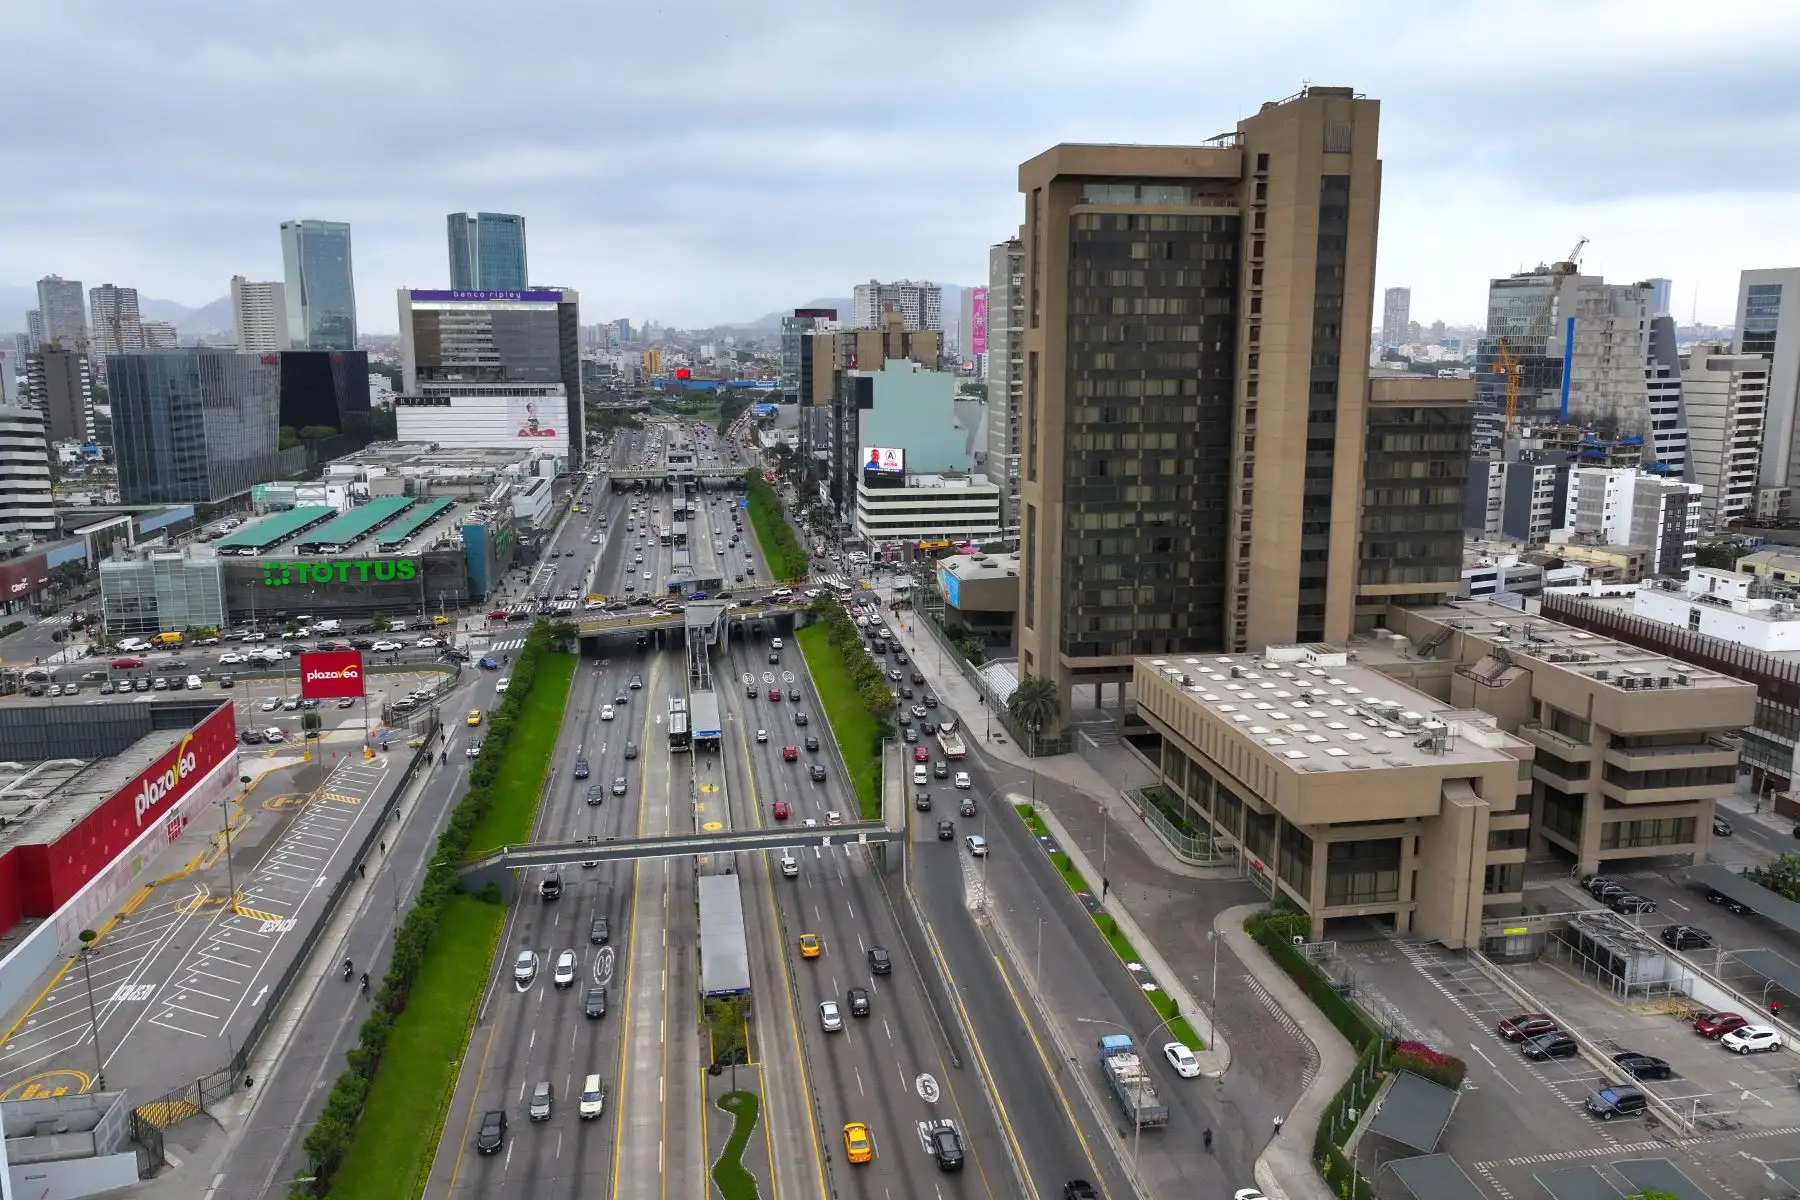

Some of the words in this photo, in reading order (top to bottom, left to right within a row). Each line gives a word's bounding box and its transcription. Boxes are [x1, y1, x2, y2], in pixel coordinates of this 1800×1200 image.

[489, 291, 521, 299] ripley
[292, 559, 416, 584] TOTTUS
[306, 664, 358, 683] plazavea
[134, 733, 196, 828] plazavea
